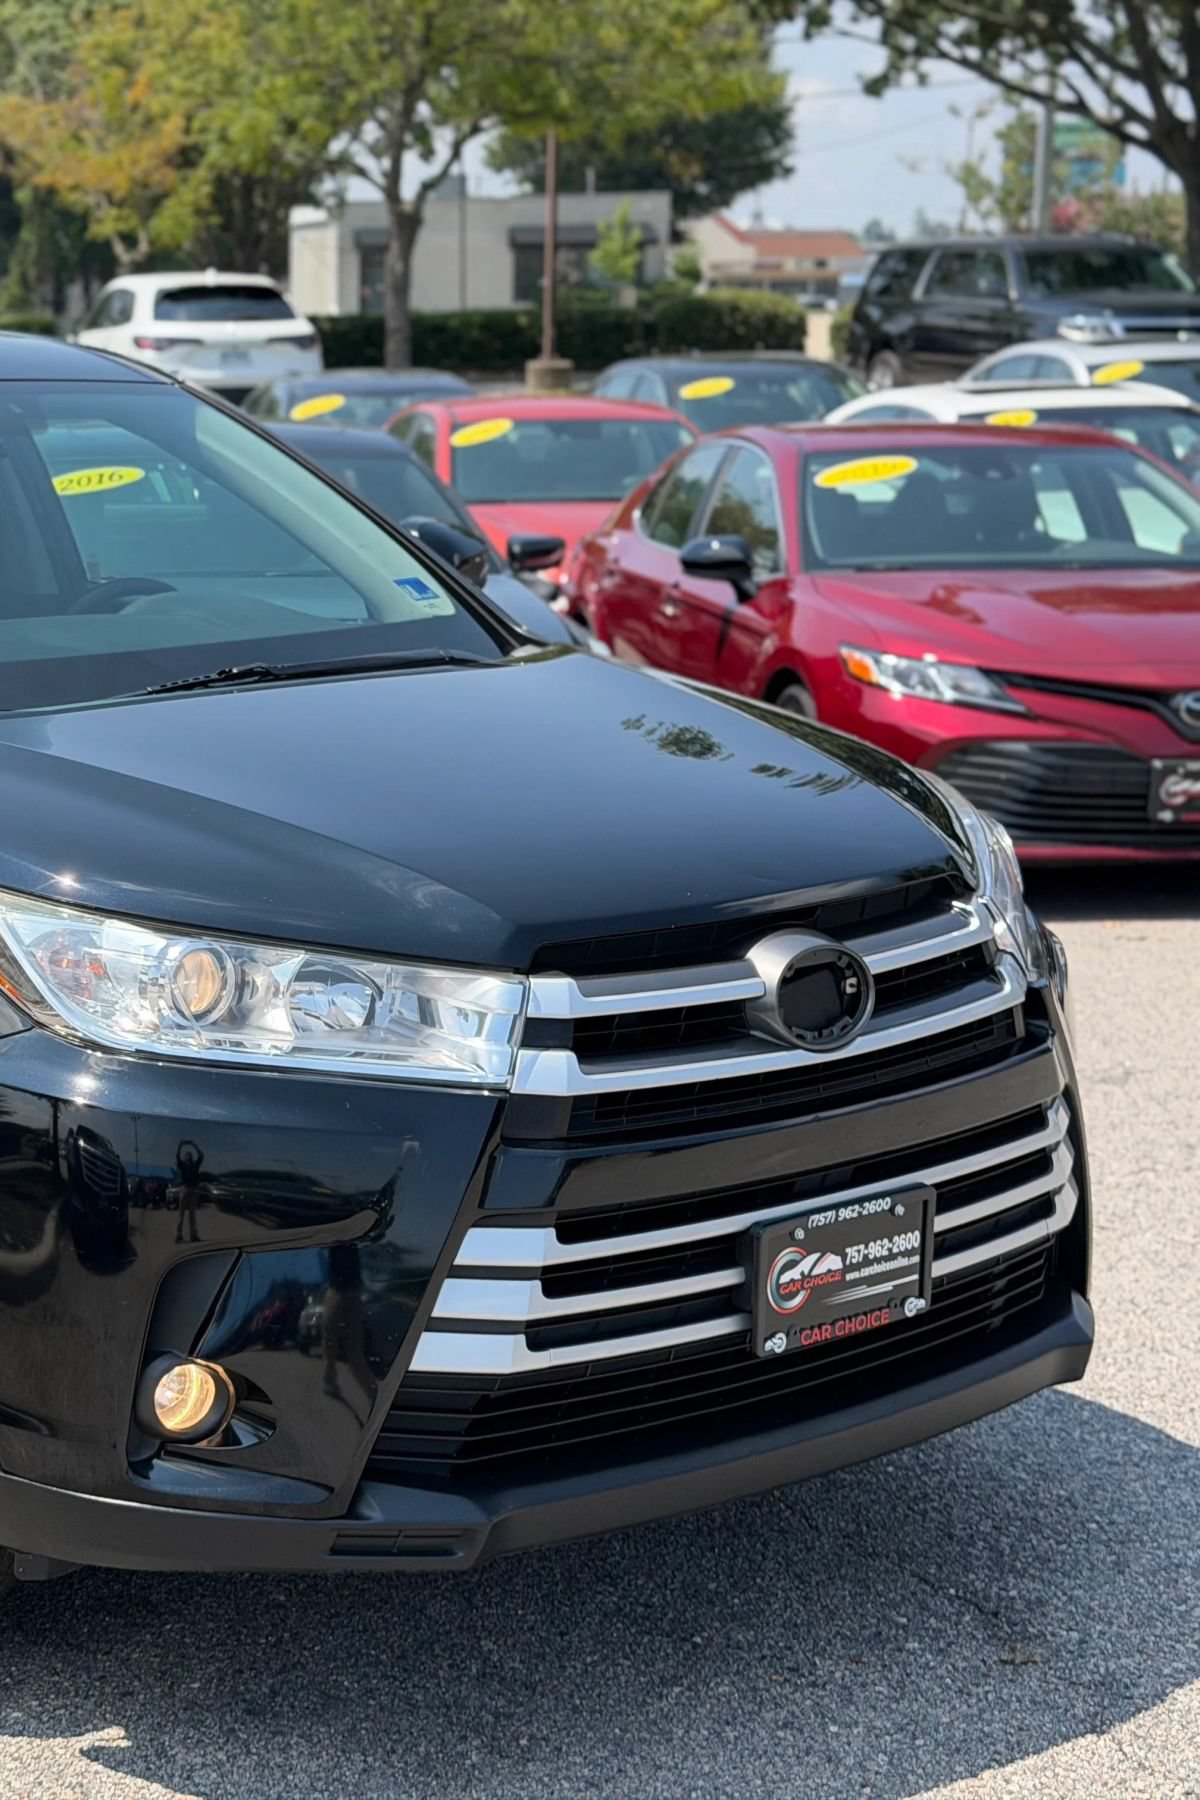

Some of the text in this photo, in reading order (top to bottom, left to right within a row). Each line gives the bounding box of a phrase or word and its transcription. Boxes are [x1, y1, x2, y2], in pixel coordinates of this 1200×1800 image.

[60, 469, 124, 491] 2016
[808, 1197, 891, 1229] (757) 962-2600
[845, 1230, 921, 1266] 757-962-2600
[780, 1271, 843, 1294] CAR CHOICE
[801, 1309, 890, 1345] CAR CHOICE
